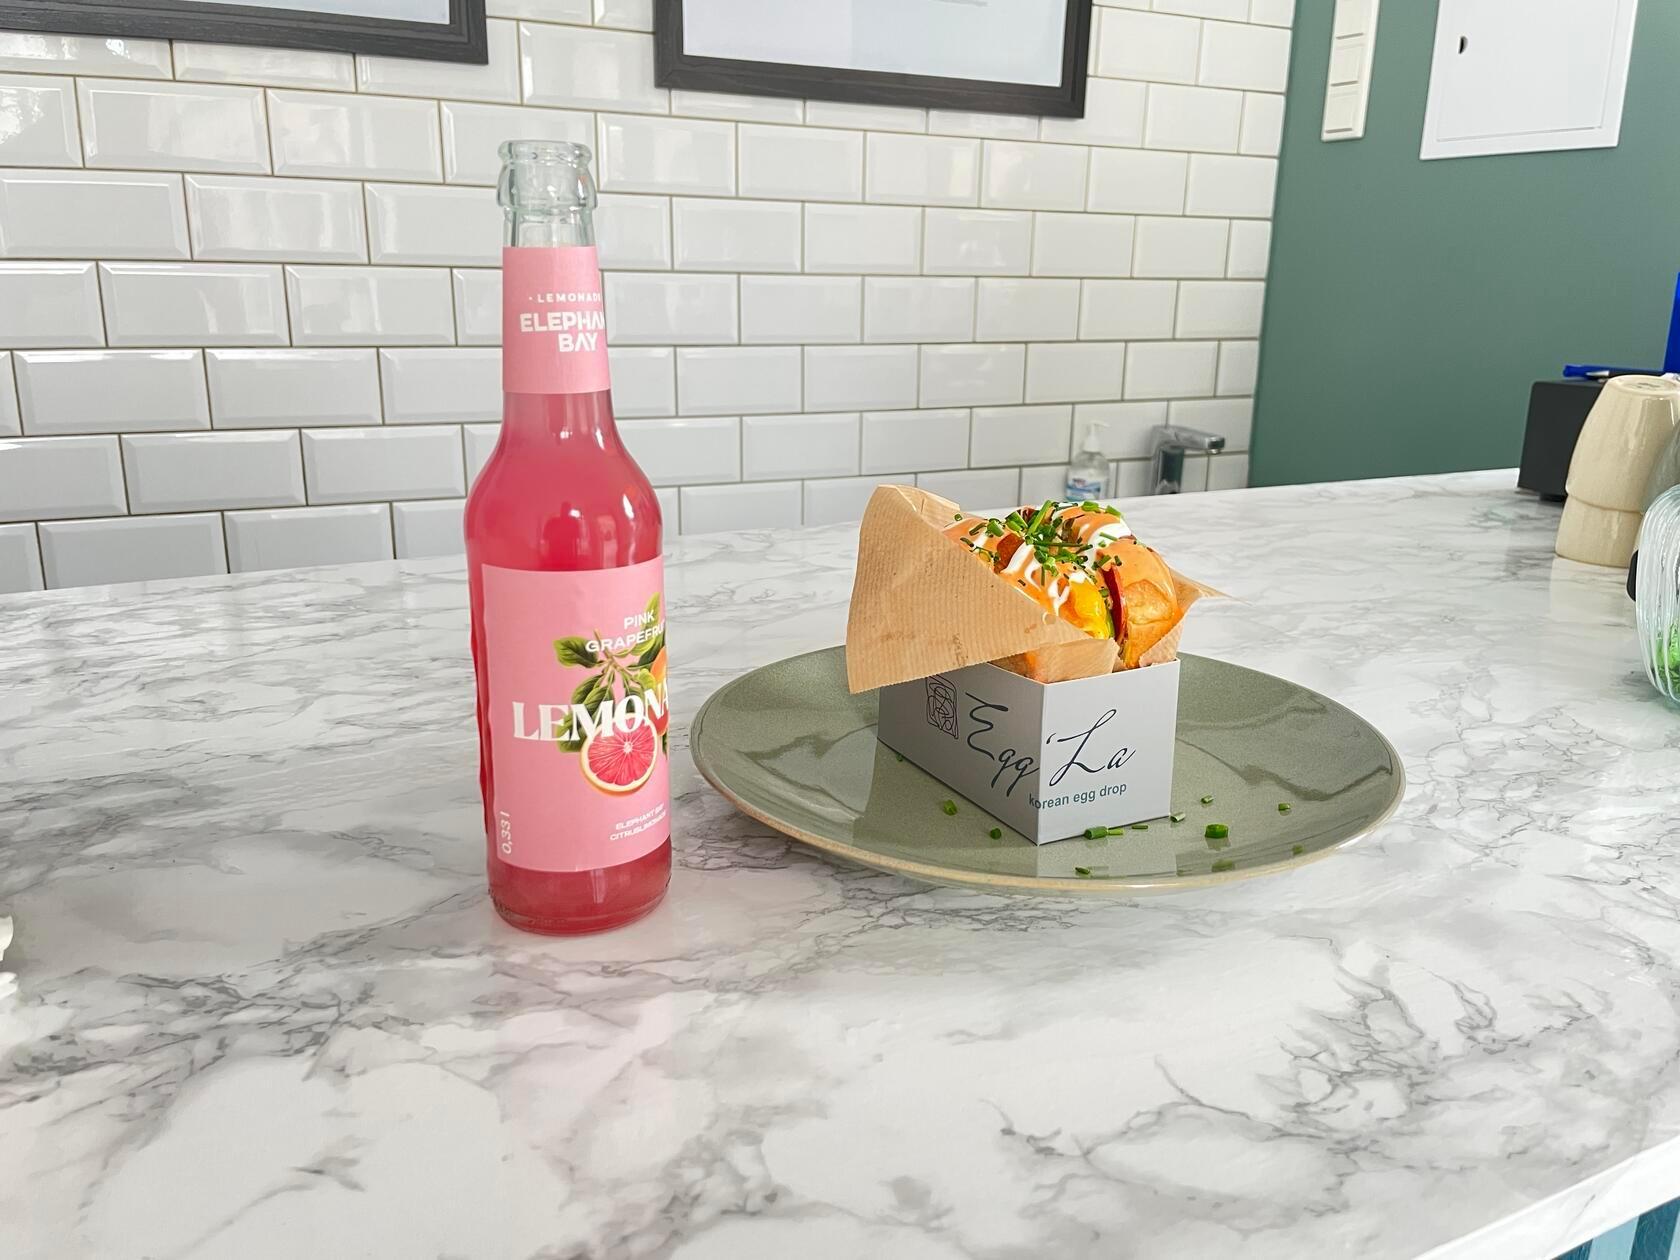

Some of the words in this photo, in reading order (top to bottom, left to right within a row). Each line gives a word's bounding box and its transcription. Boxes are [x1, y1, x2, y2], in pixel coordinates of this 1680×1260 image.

[558, 332, 598, 353] BAY
[624, 609, 655, 630] PINK
[965, 690, 1040, 797] Egg
[1028, 793, 1070, 810] korean
[1073, 789, 1097, 803] egg
[1100, 782, 1128, 798] drop
[500, 819, 513, 855] 0,33
